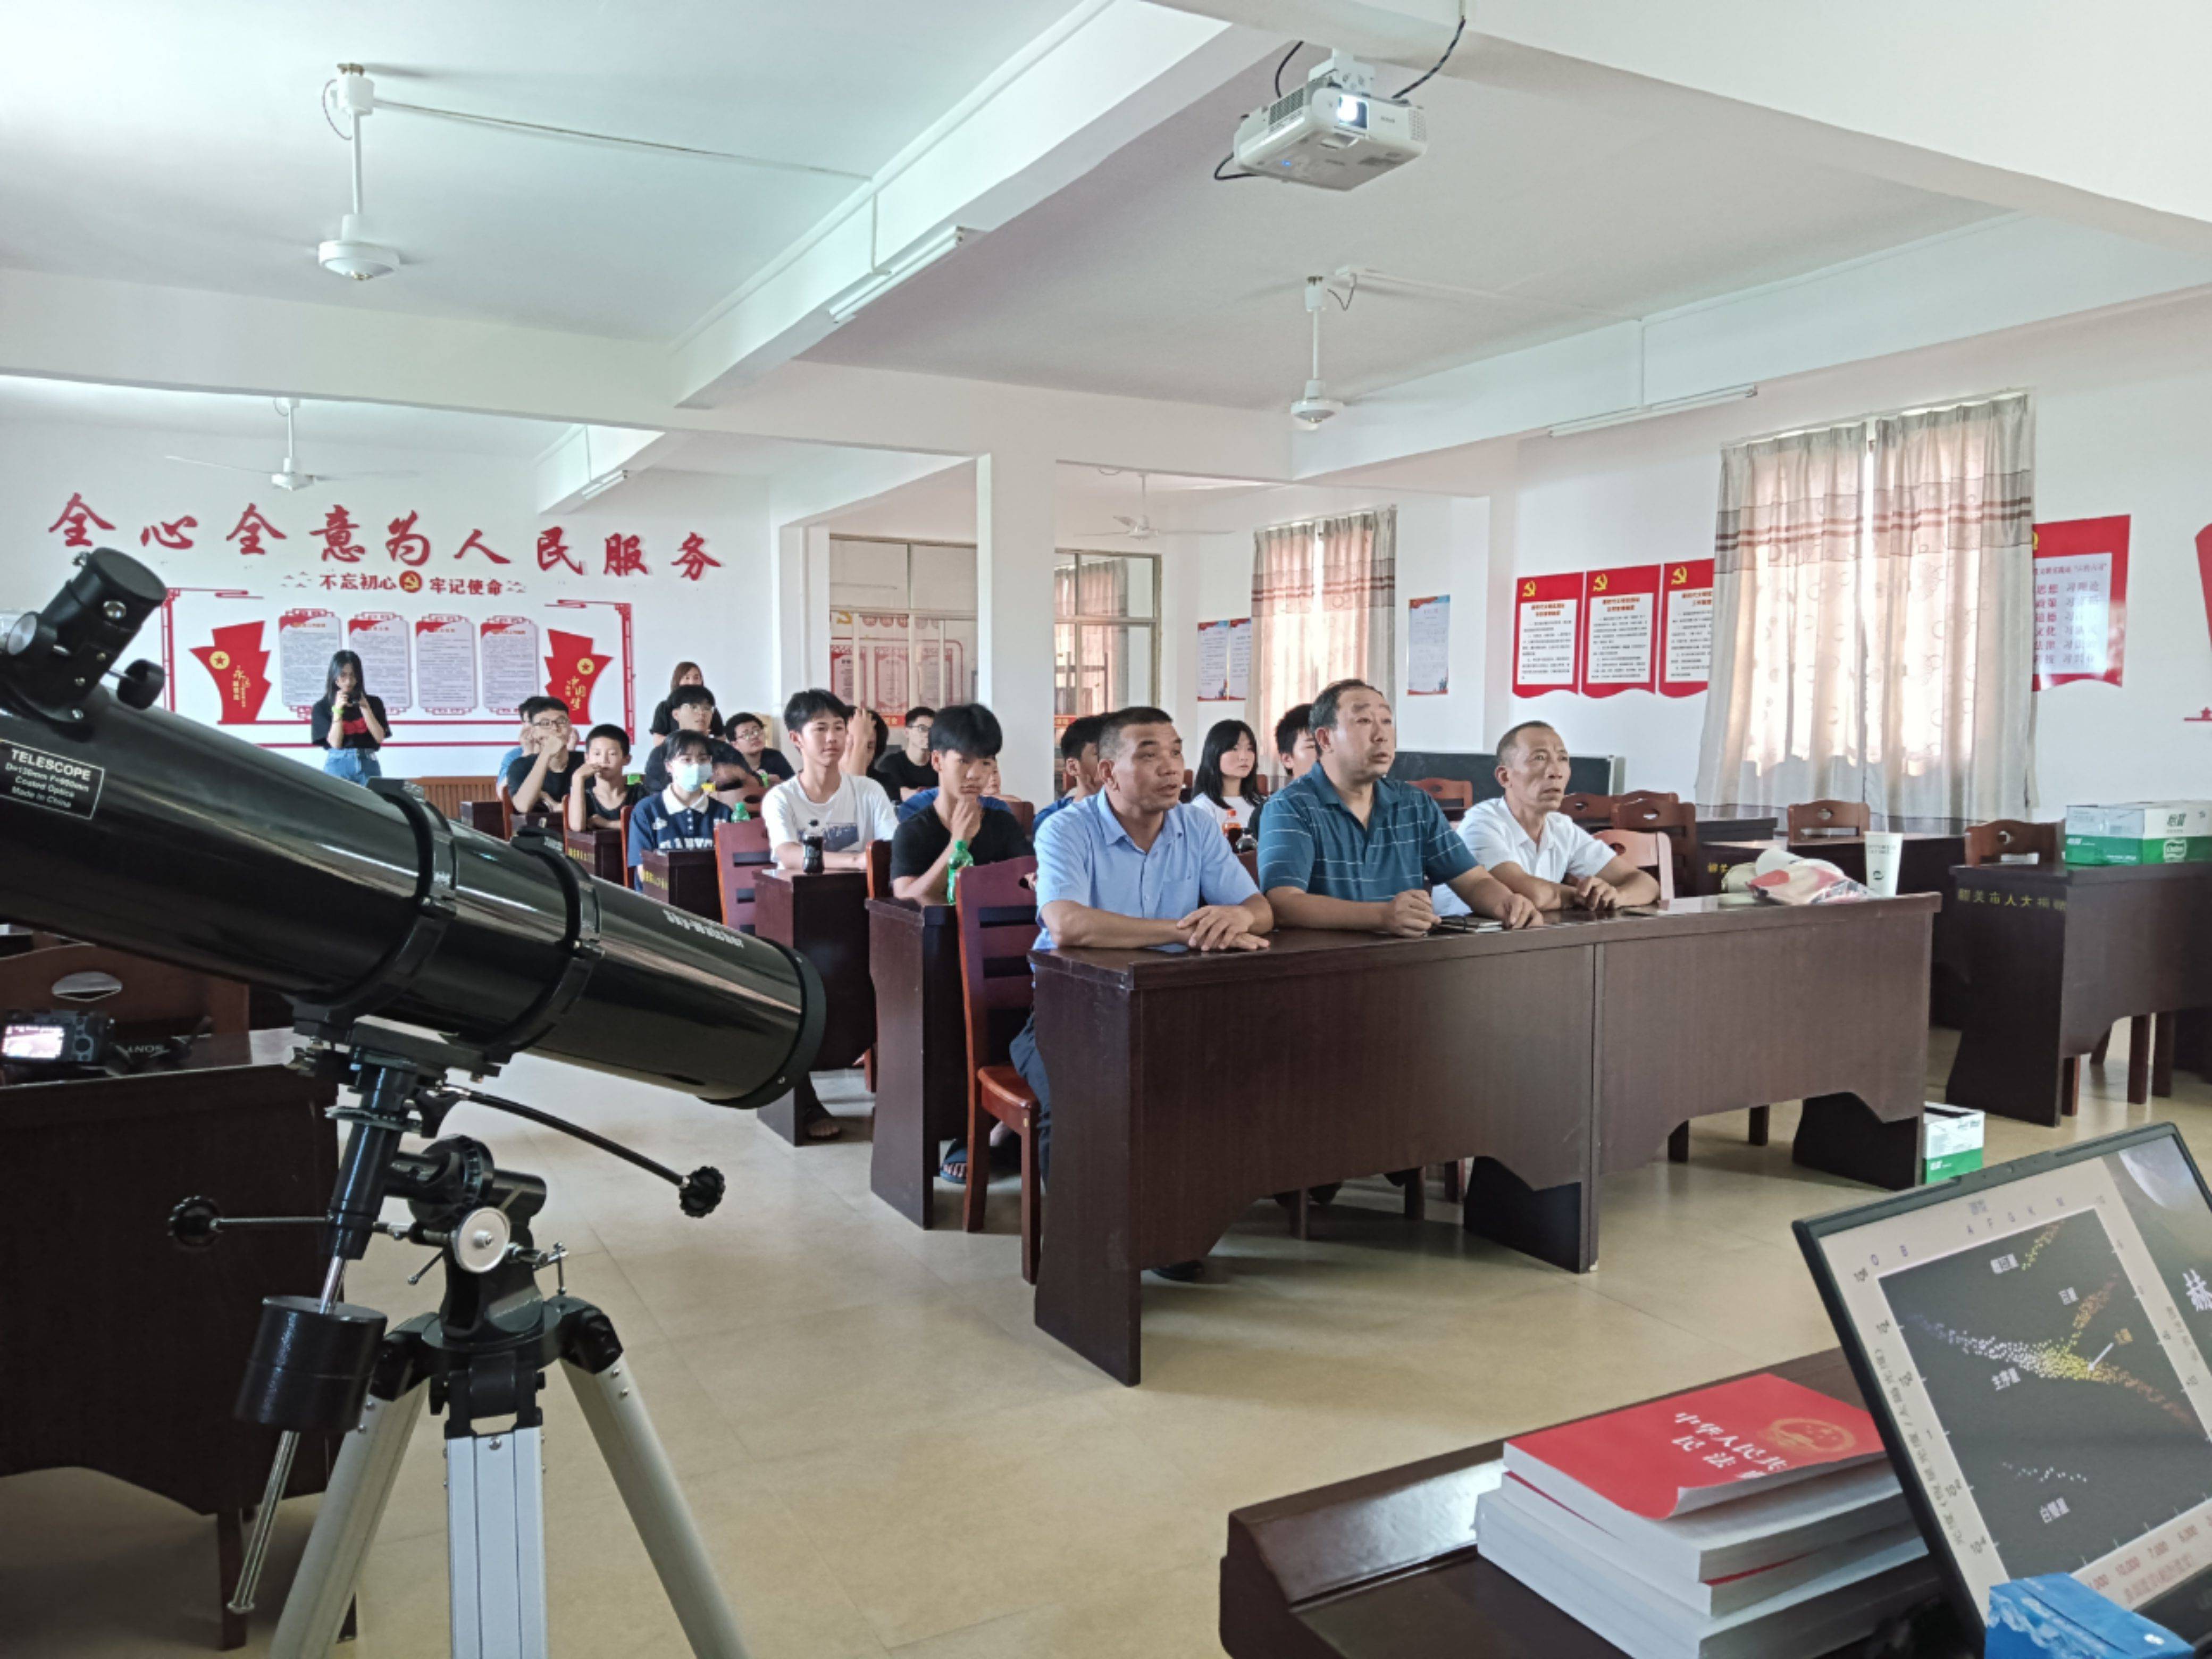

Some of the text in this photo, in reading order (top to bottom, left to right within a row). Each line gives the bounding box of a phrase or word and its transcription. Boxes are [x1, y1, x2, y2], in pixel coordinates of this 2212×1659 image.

[49, 492, 722, 581] 全心全意为人民服务
[320, 573, 504, 596] 不忘初心 牢记使命
[11, 748, 91, 782] TELESCOPE
[11, 786, 35, 798] Made
